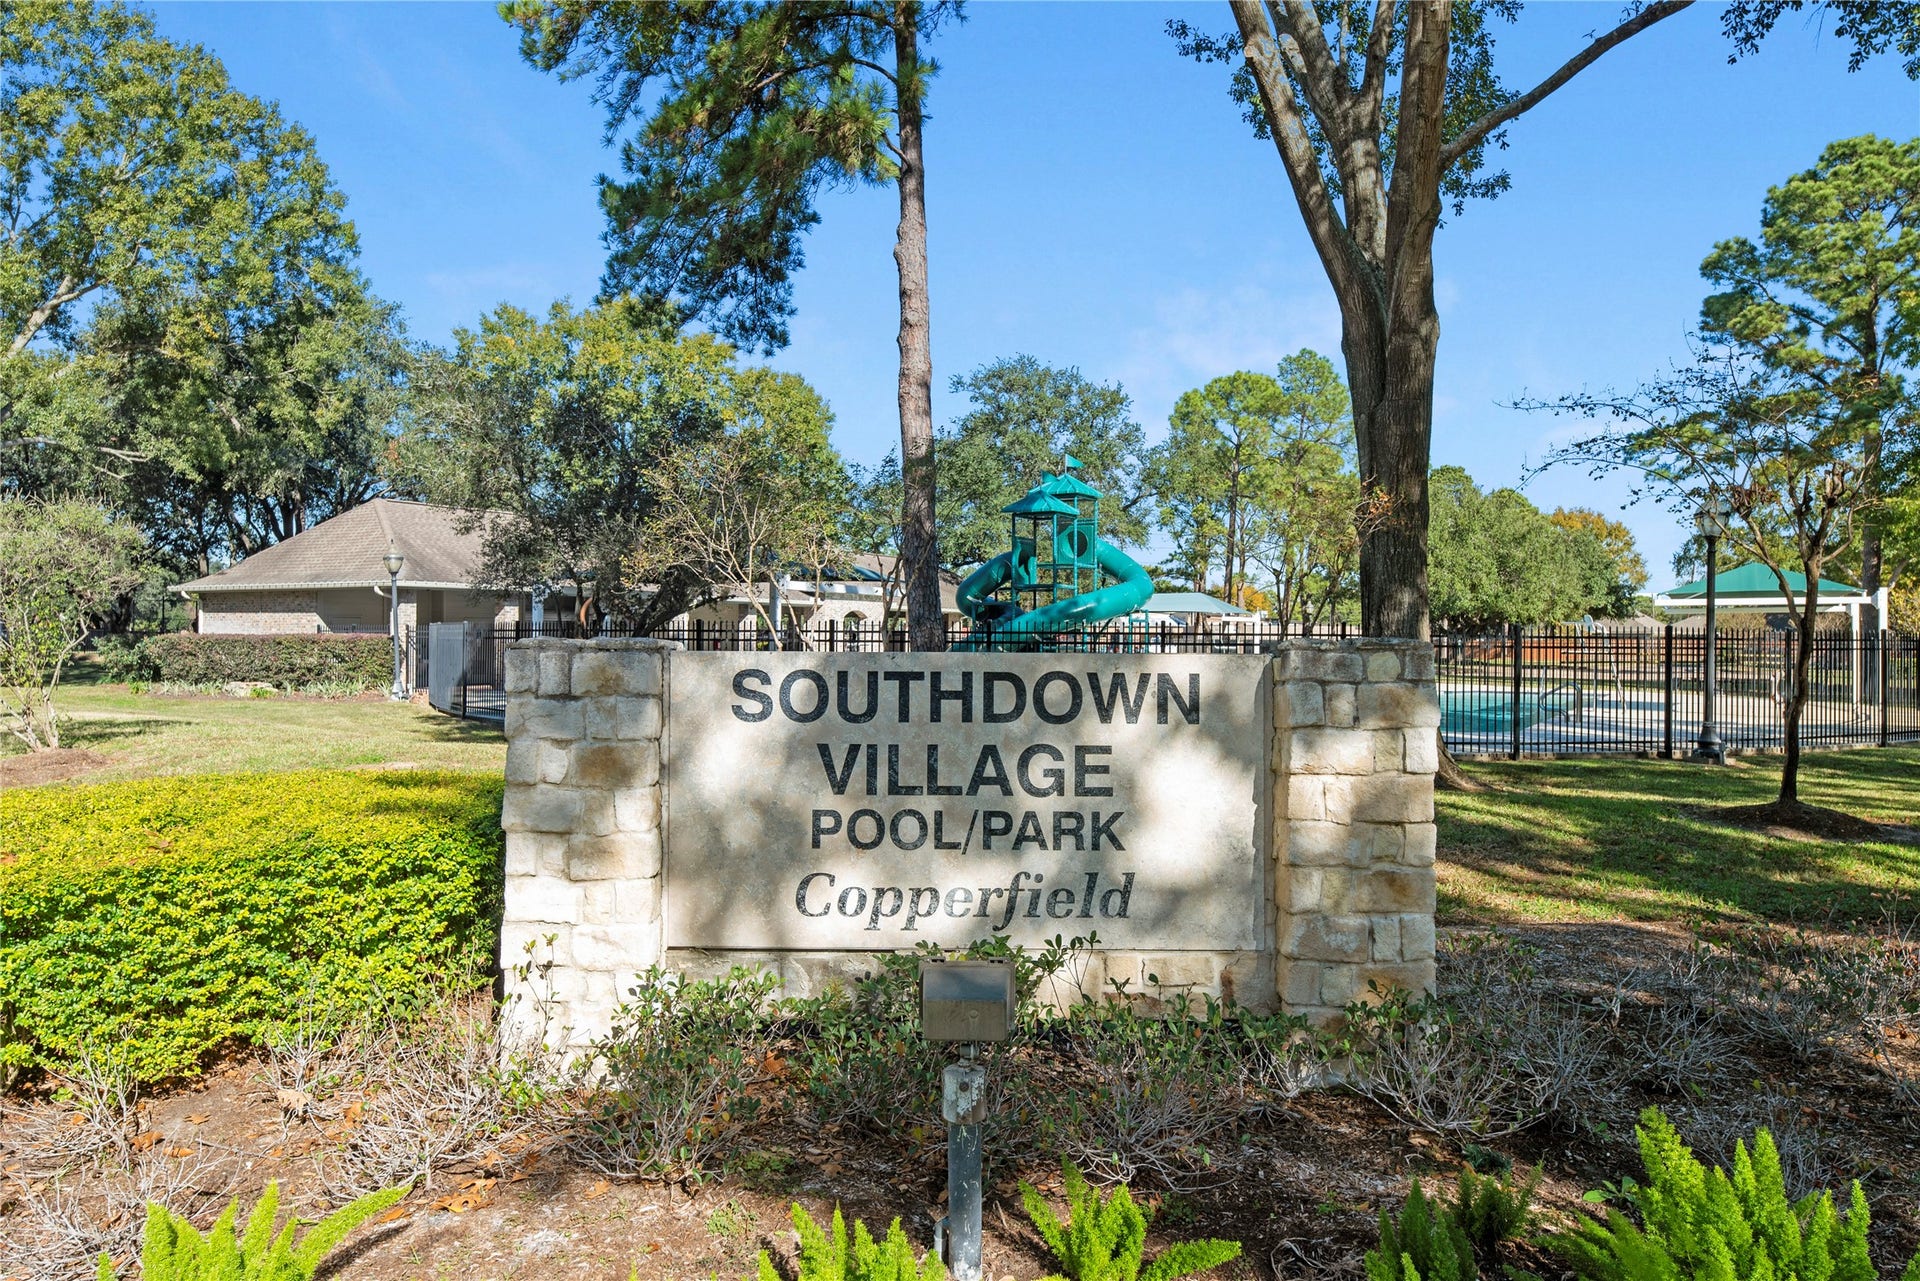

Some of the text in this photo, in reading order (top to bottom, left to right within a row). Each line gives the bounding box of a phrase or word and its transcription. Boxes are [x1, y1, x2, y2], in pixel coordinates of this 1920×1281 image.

[731, 668, 1200, 725] SOUTHDOWN
[816, 743, 1114, 798] VILLAGE
[811, 808, 1127, 855] POOL/PARK
[795, 871, 1136, 931] Copperfield
